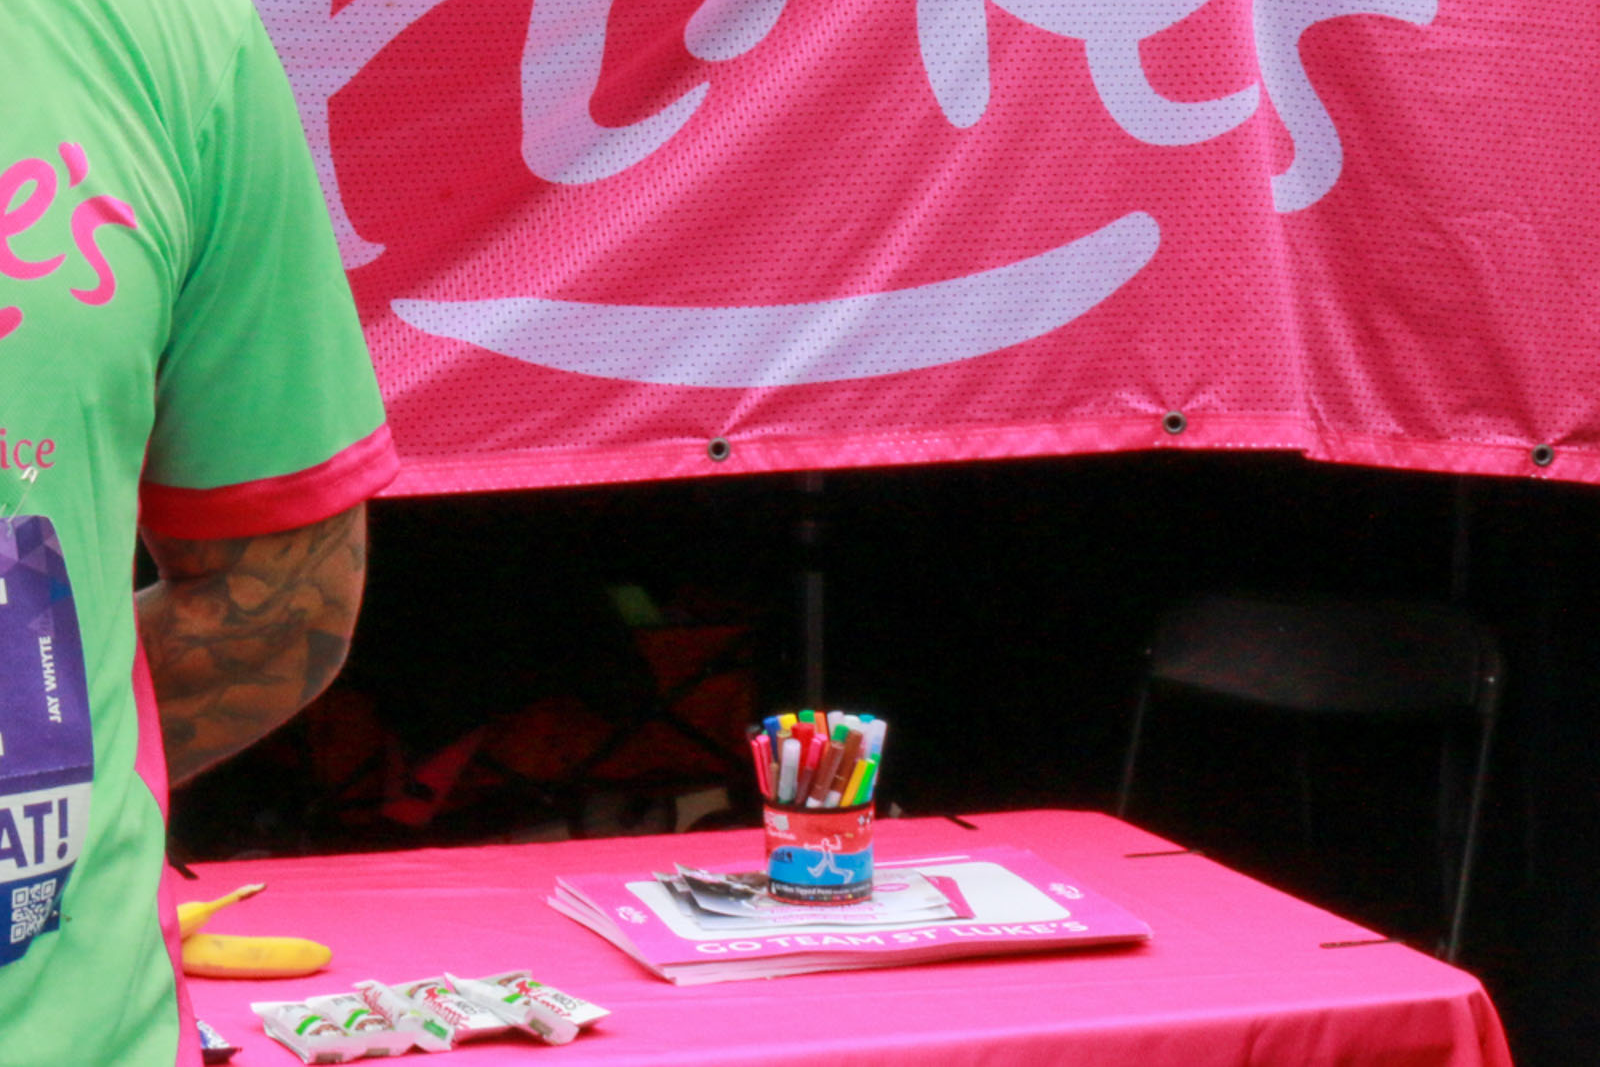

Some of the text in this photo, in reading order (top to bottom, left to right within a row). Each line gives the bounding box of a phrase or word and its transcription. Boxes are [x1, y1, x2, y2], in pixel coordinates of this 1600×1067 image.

[38, 635, 62, 723] JAY WHYTE
[696, 920, 1089, 955] GO TEAM ST LUKE'S
